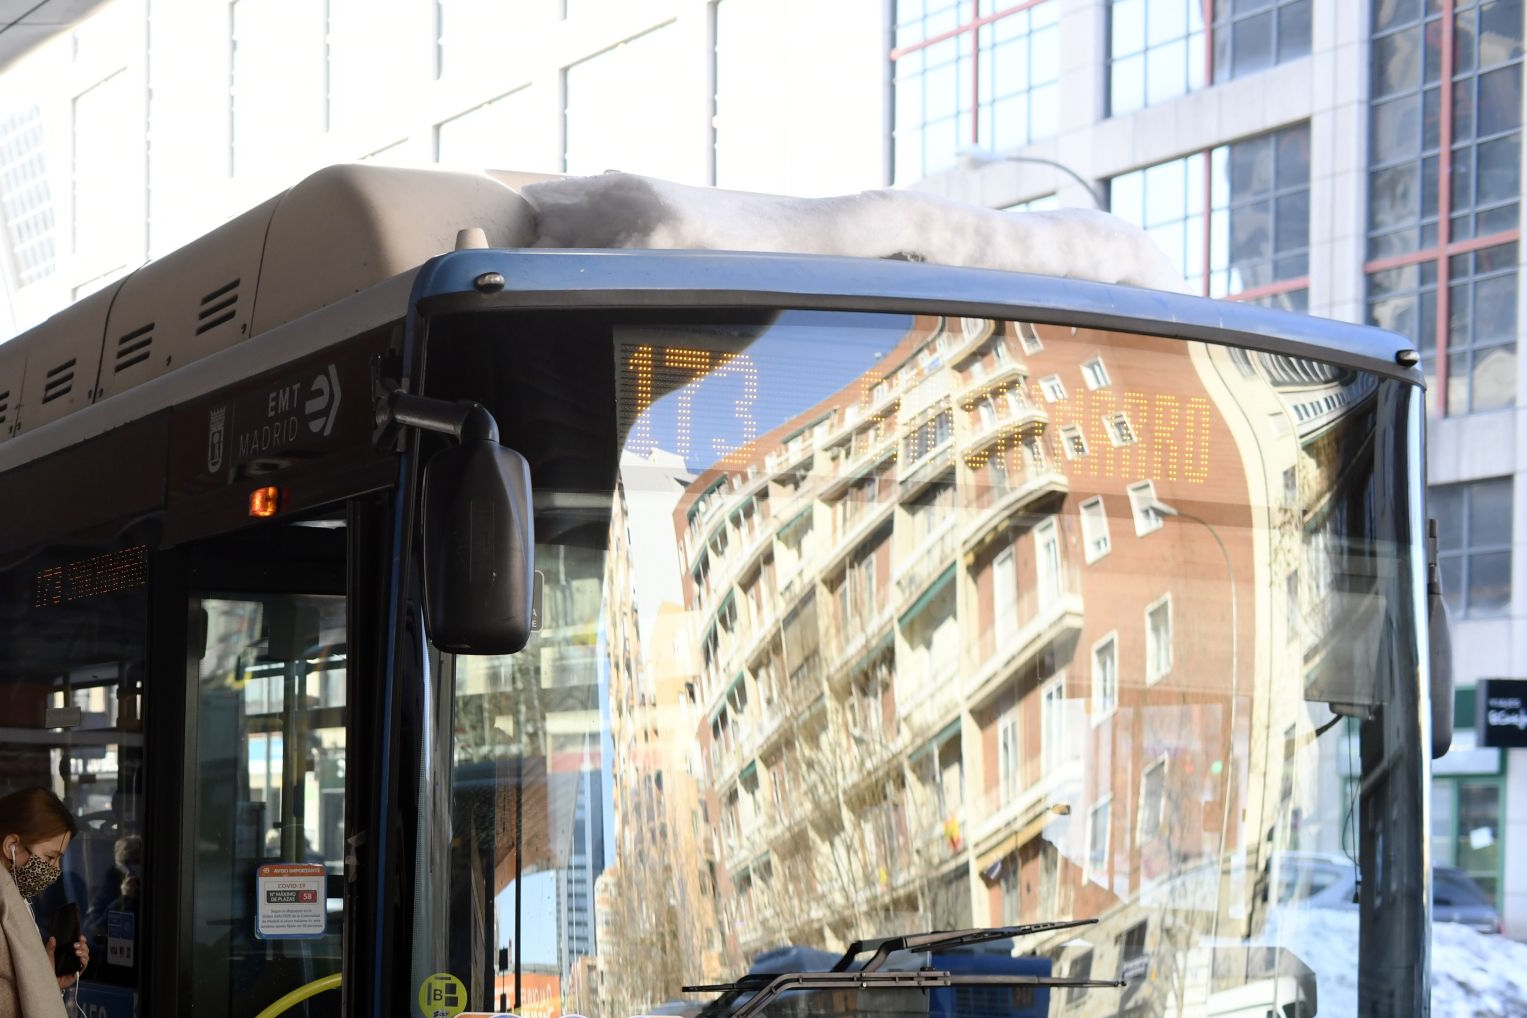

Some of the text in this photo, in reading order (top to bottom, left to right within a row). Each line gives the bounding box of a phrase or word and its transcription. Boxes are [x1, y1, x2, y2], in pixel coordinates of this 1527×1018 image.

[267, 383, 301, 417] EMT
[628, 345, 758, 464] 173
[239, 416, 299, 457] MADRID
[433, 988, 443, 1001] B
